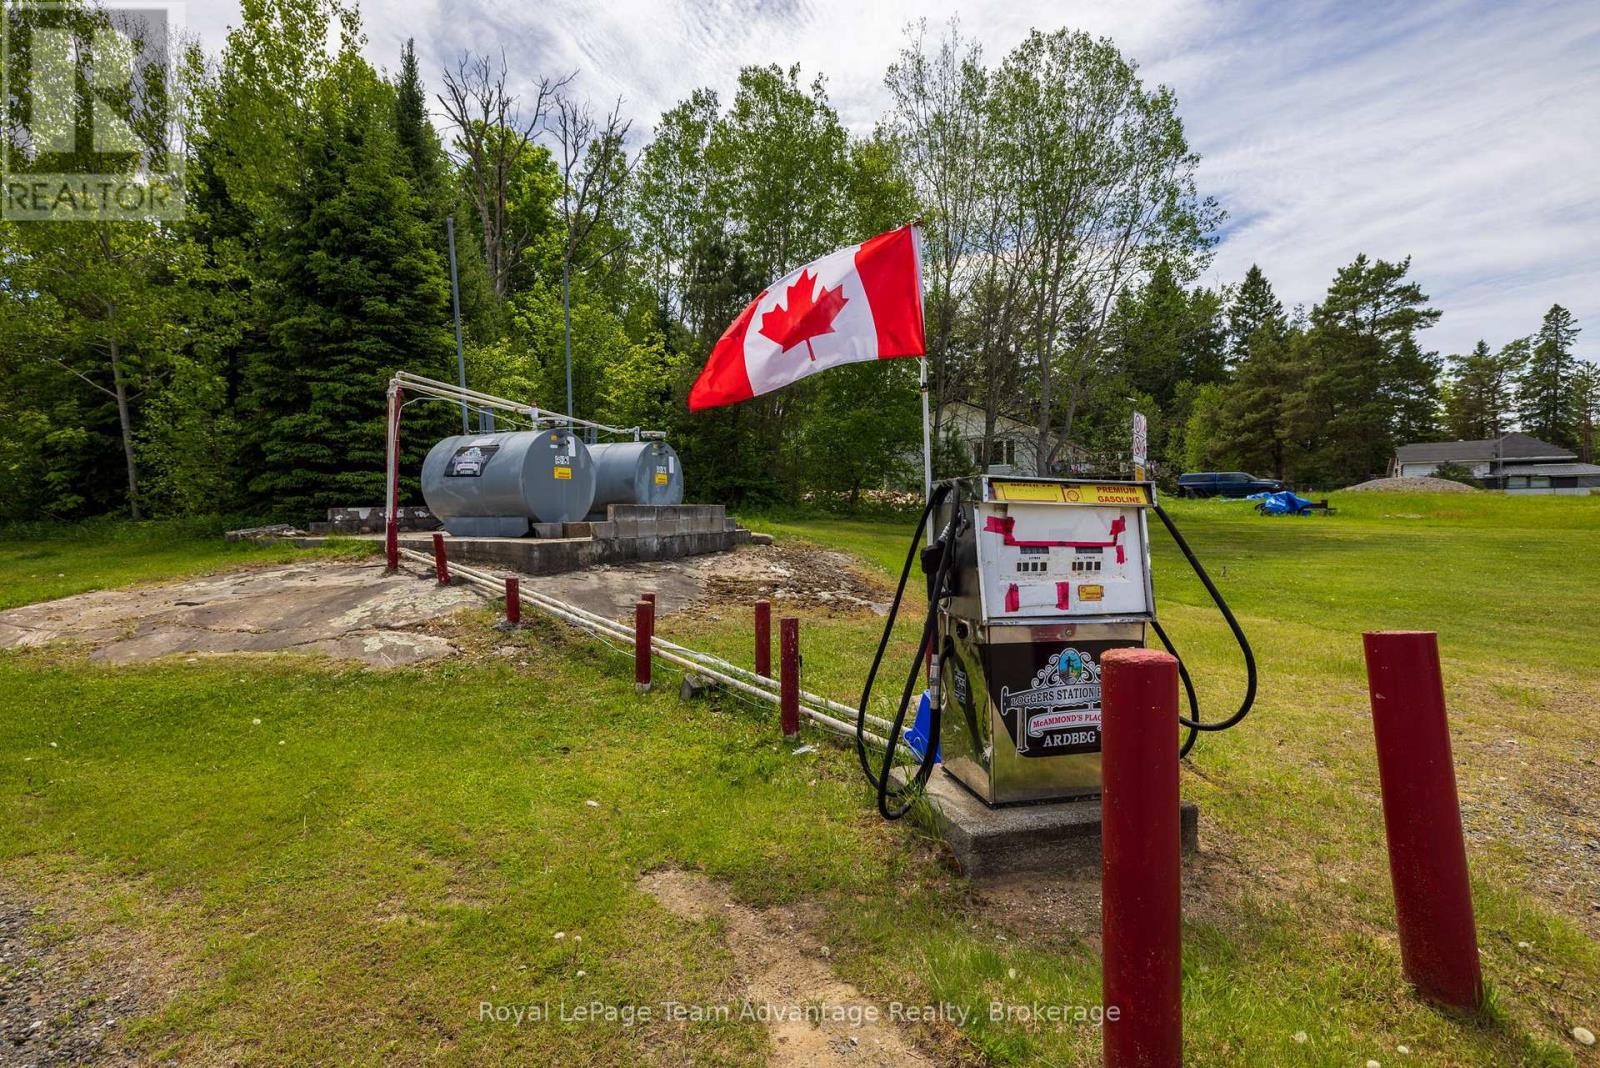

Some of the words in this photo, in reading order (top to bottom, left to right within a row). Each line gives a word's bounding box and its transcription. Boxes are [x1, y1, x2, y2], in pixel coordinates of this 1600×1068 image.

[1096, 486, 1137, 494] PREMIUM
[1097, 495, 1141, 503] GASOLINE
[1011, 691, 1053, 705] LOGGERS
[1057, 688, 1093, 700] STATION
[1033, 715, 1082, 727] McAMMOND'S
[1043, 732, 1095, 747] ARDBEG
